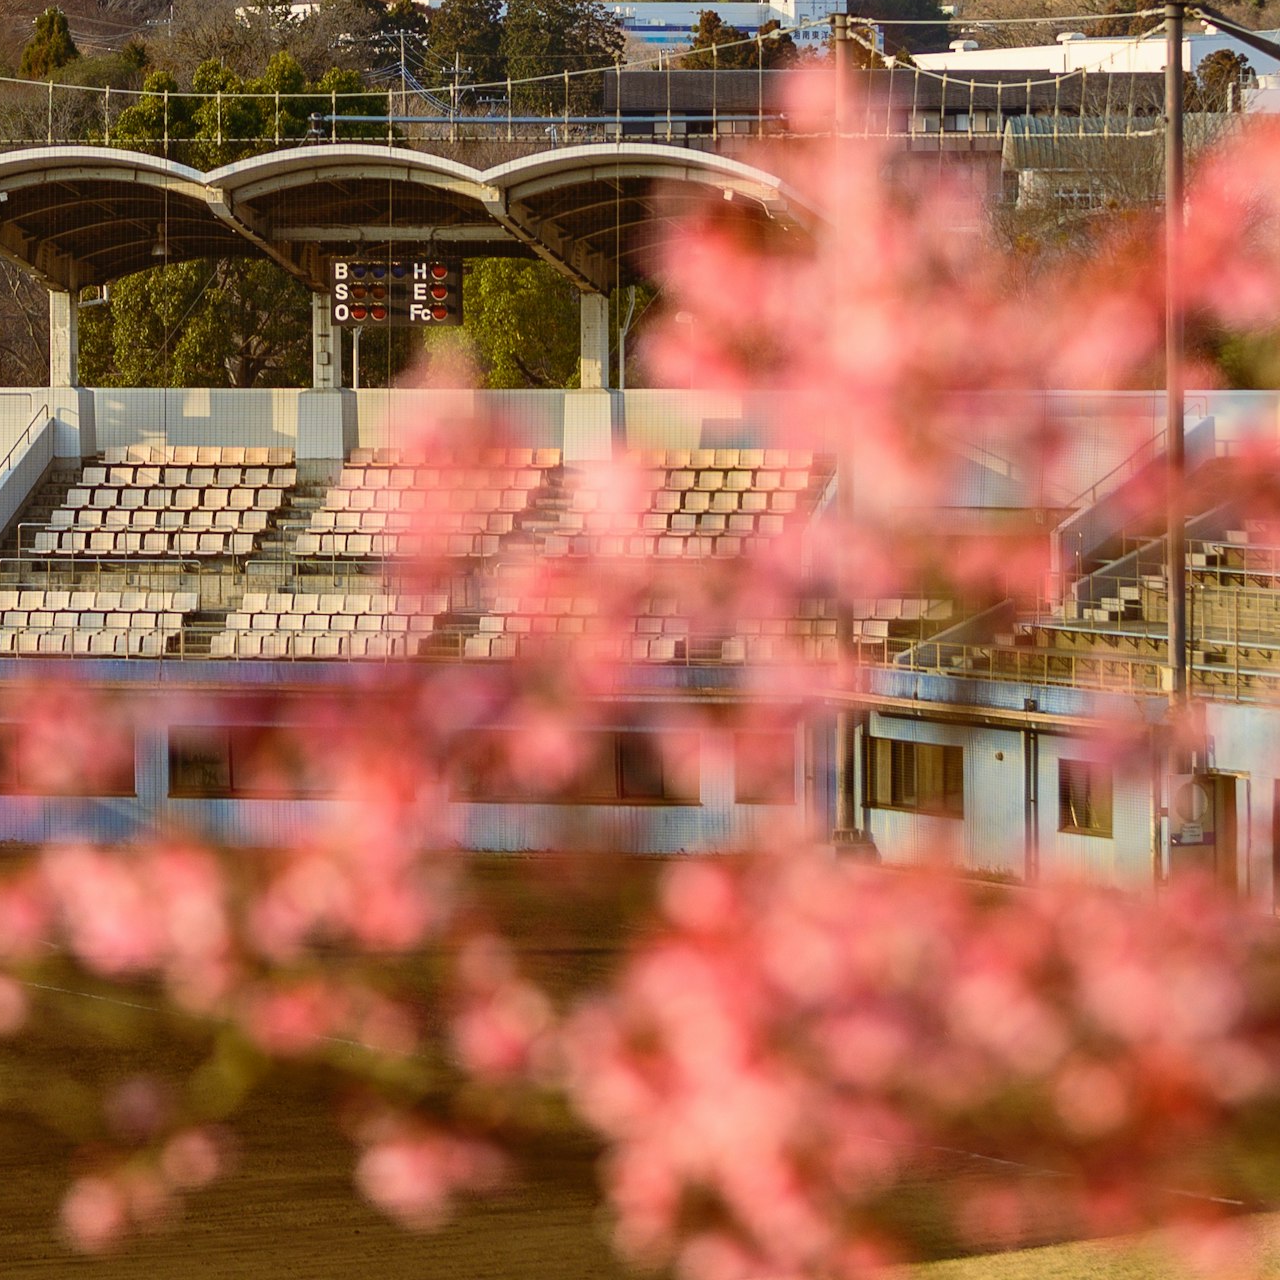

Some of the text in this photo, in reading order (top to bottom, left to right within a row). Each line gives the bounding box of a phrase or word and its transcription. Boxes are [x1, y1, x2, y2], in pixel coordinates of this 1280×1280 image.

[335, 263, 427, 280] B H
[335, 283, 427, 300] S E
[335, 304, 432, 321] O Fc
